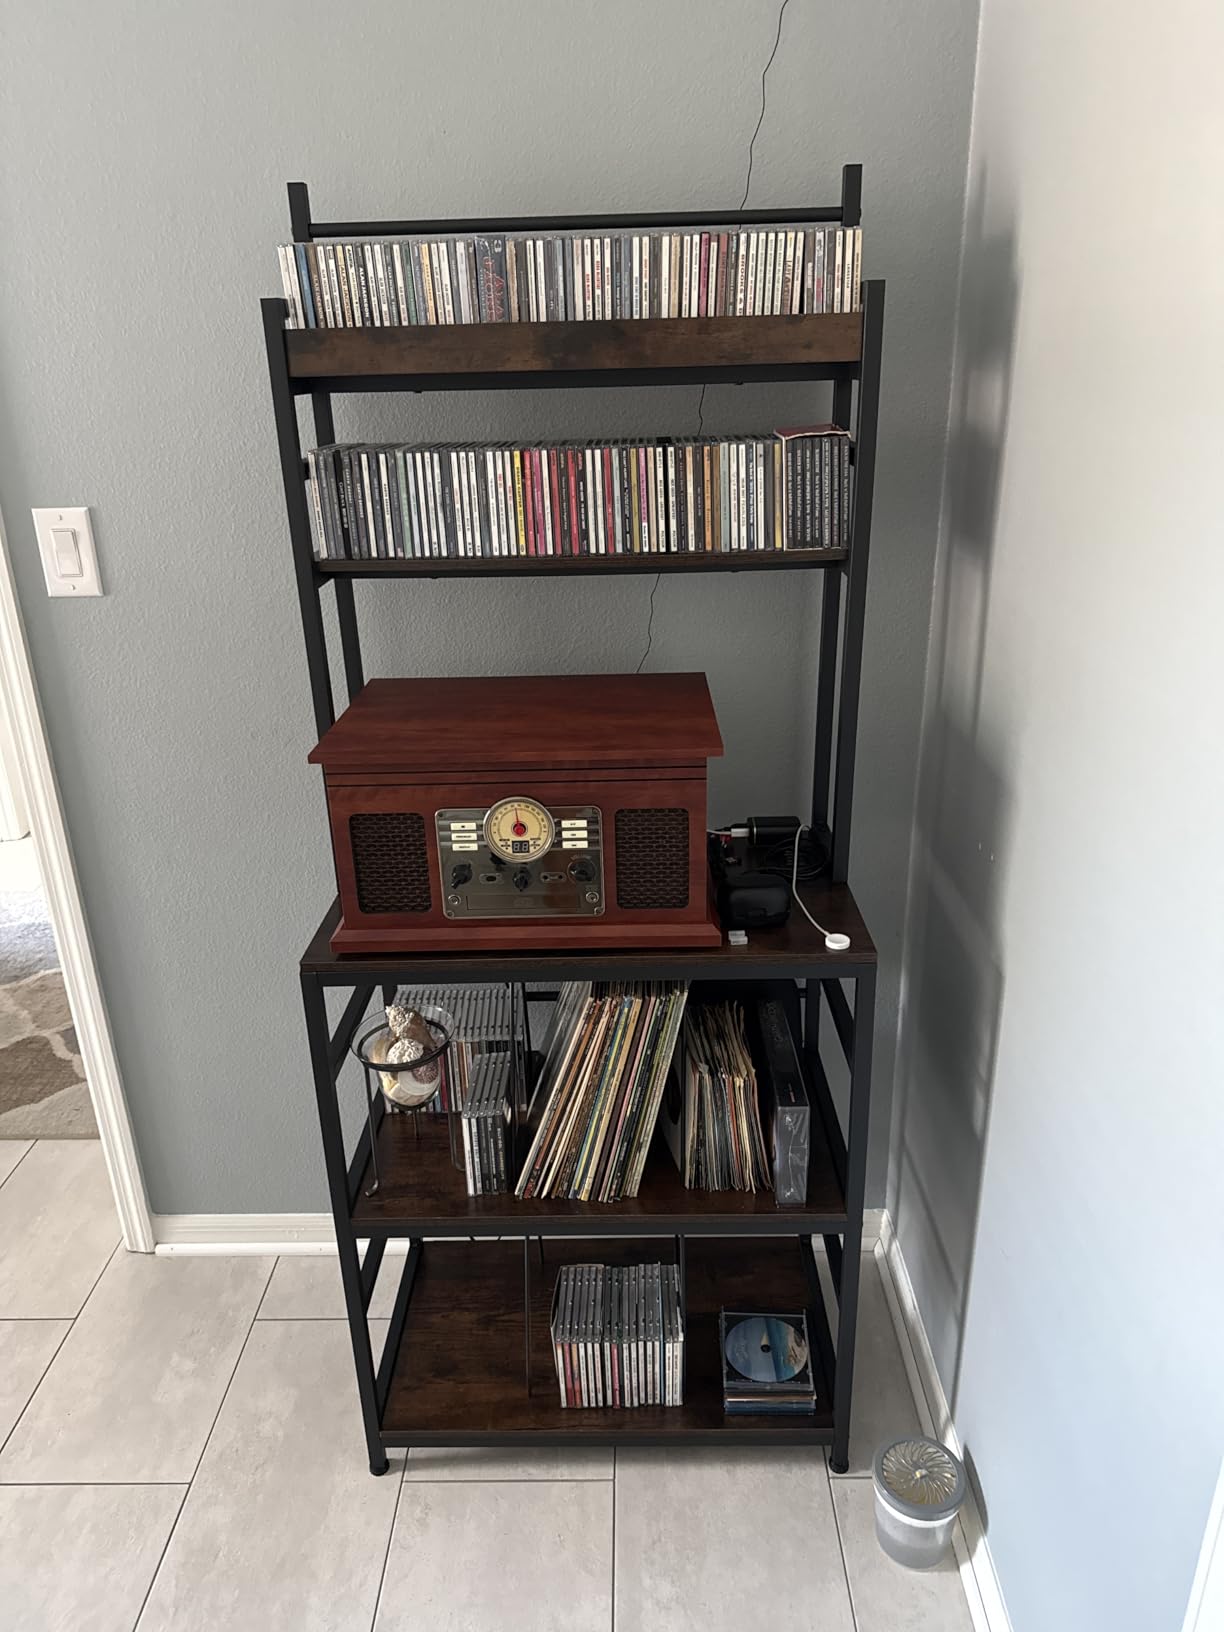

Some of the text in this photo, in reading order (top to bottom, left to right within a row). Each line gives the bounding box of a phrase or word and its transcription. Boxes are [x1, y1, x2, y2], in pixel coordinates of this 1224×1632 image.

[339, 266, 347, 286] ALAN
[342, 287, 352, 322] JACKSON
[361, 286, 369, 317] JACKSON
